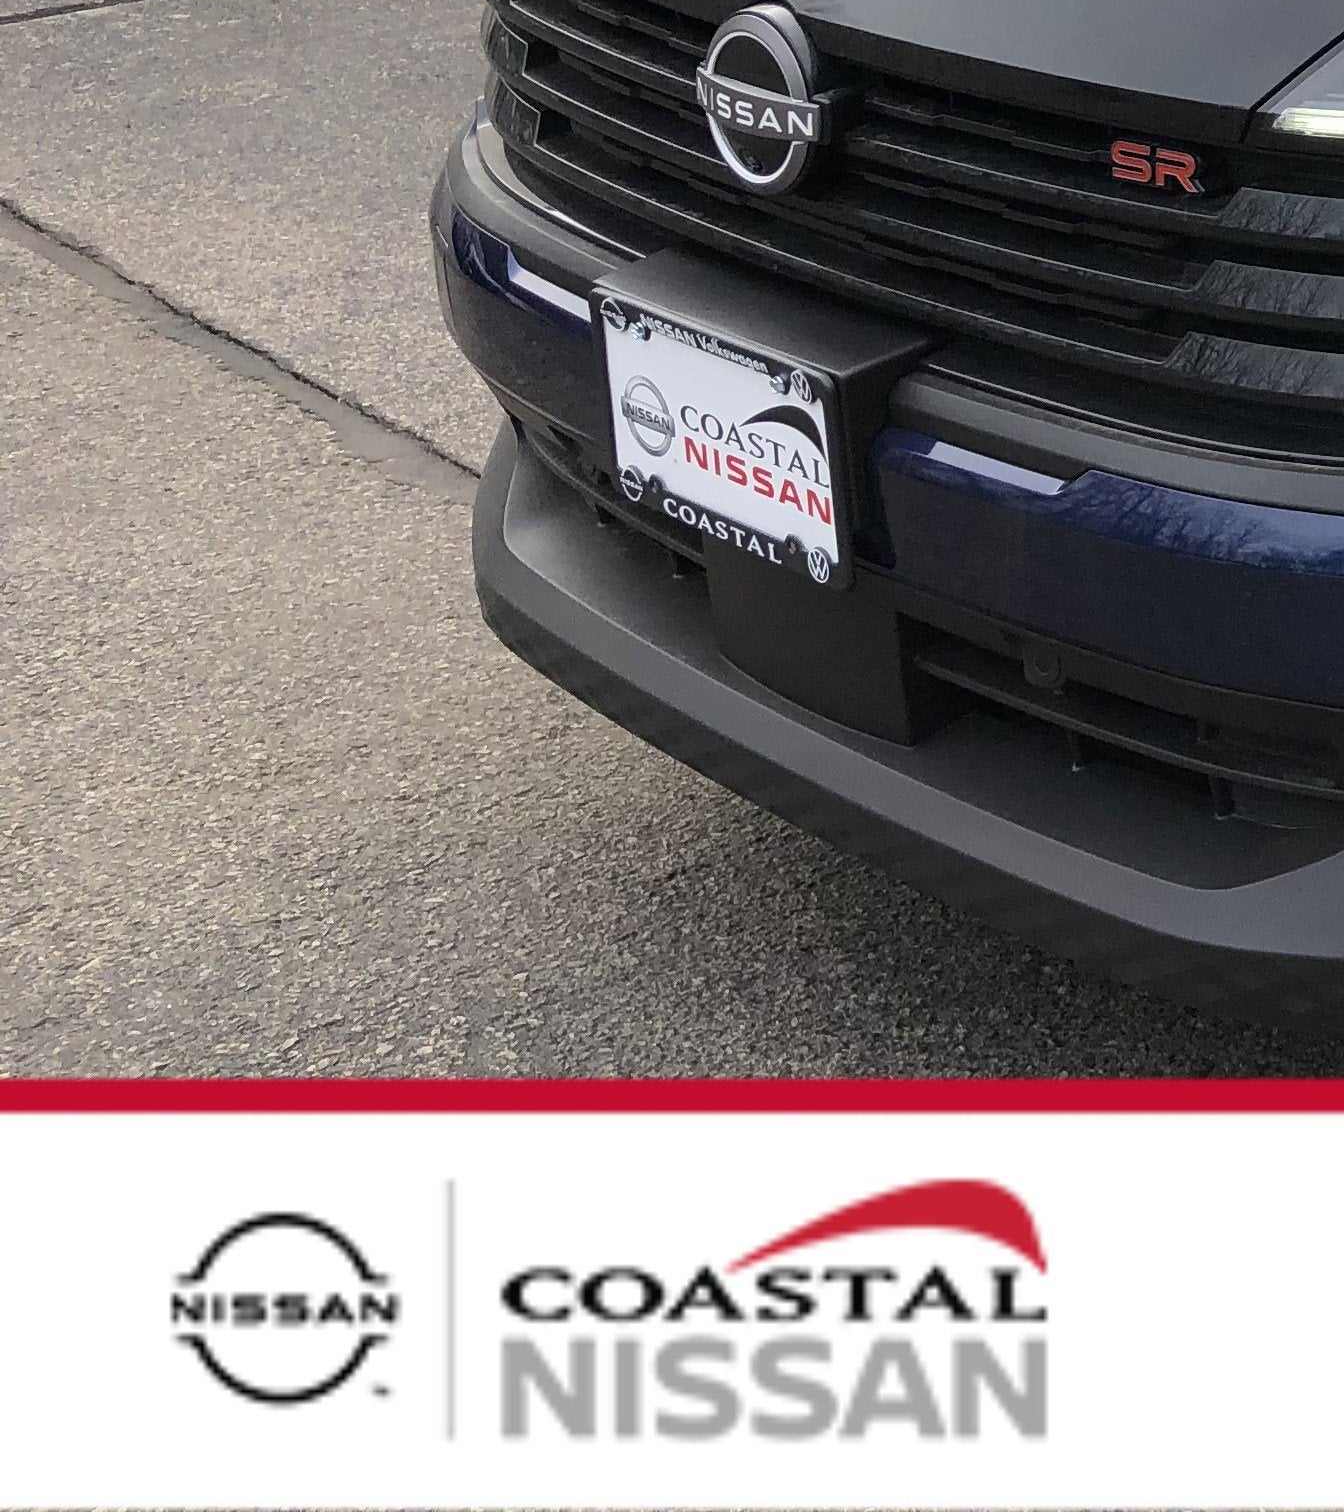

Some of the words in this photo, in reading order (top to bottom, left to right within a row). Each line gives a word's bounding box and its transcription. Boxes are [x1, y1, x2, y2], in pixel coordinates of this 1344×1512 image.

[696, 76, 814, 137] NISSAN
[1110, 140, 1200, 194] SR
[639, 312, 698, 349] NISSAN
[697, 334, 769, 374] Volkswagen
[625, 402, 671, 432] NISSAN
[680, 405, 829, 489] COASTAL
[684, 436, 832, 526] NISSAN
[662, 498, 783, 565] COASTAL
